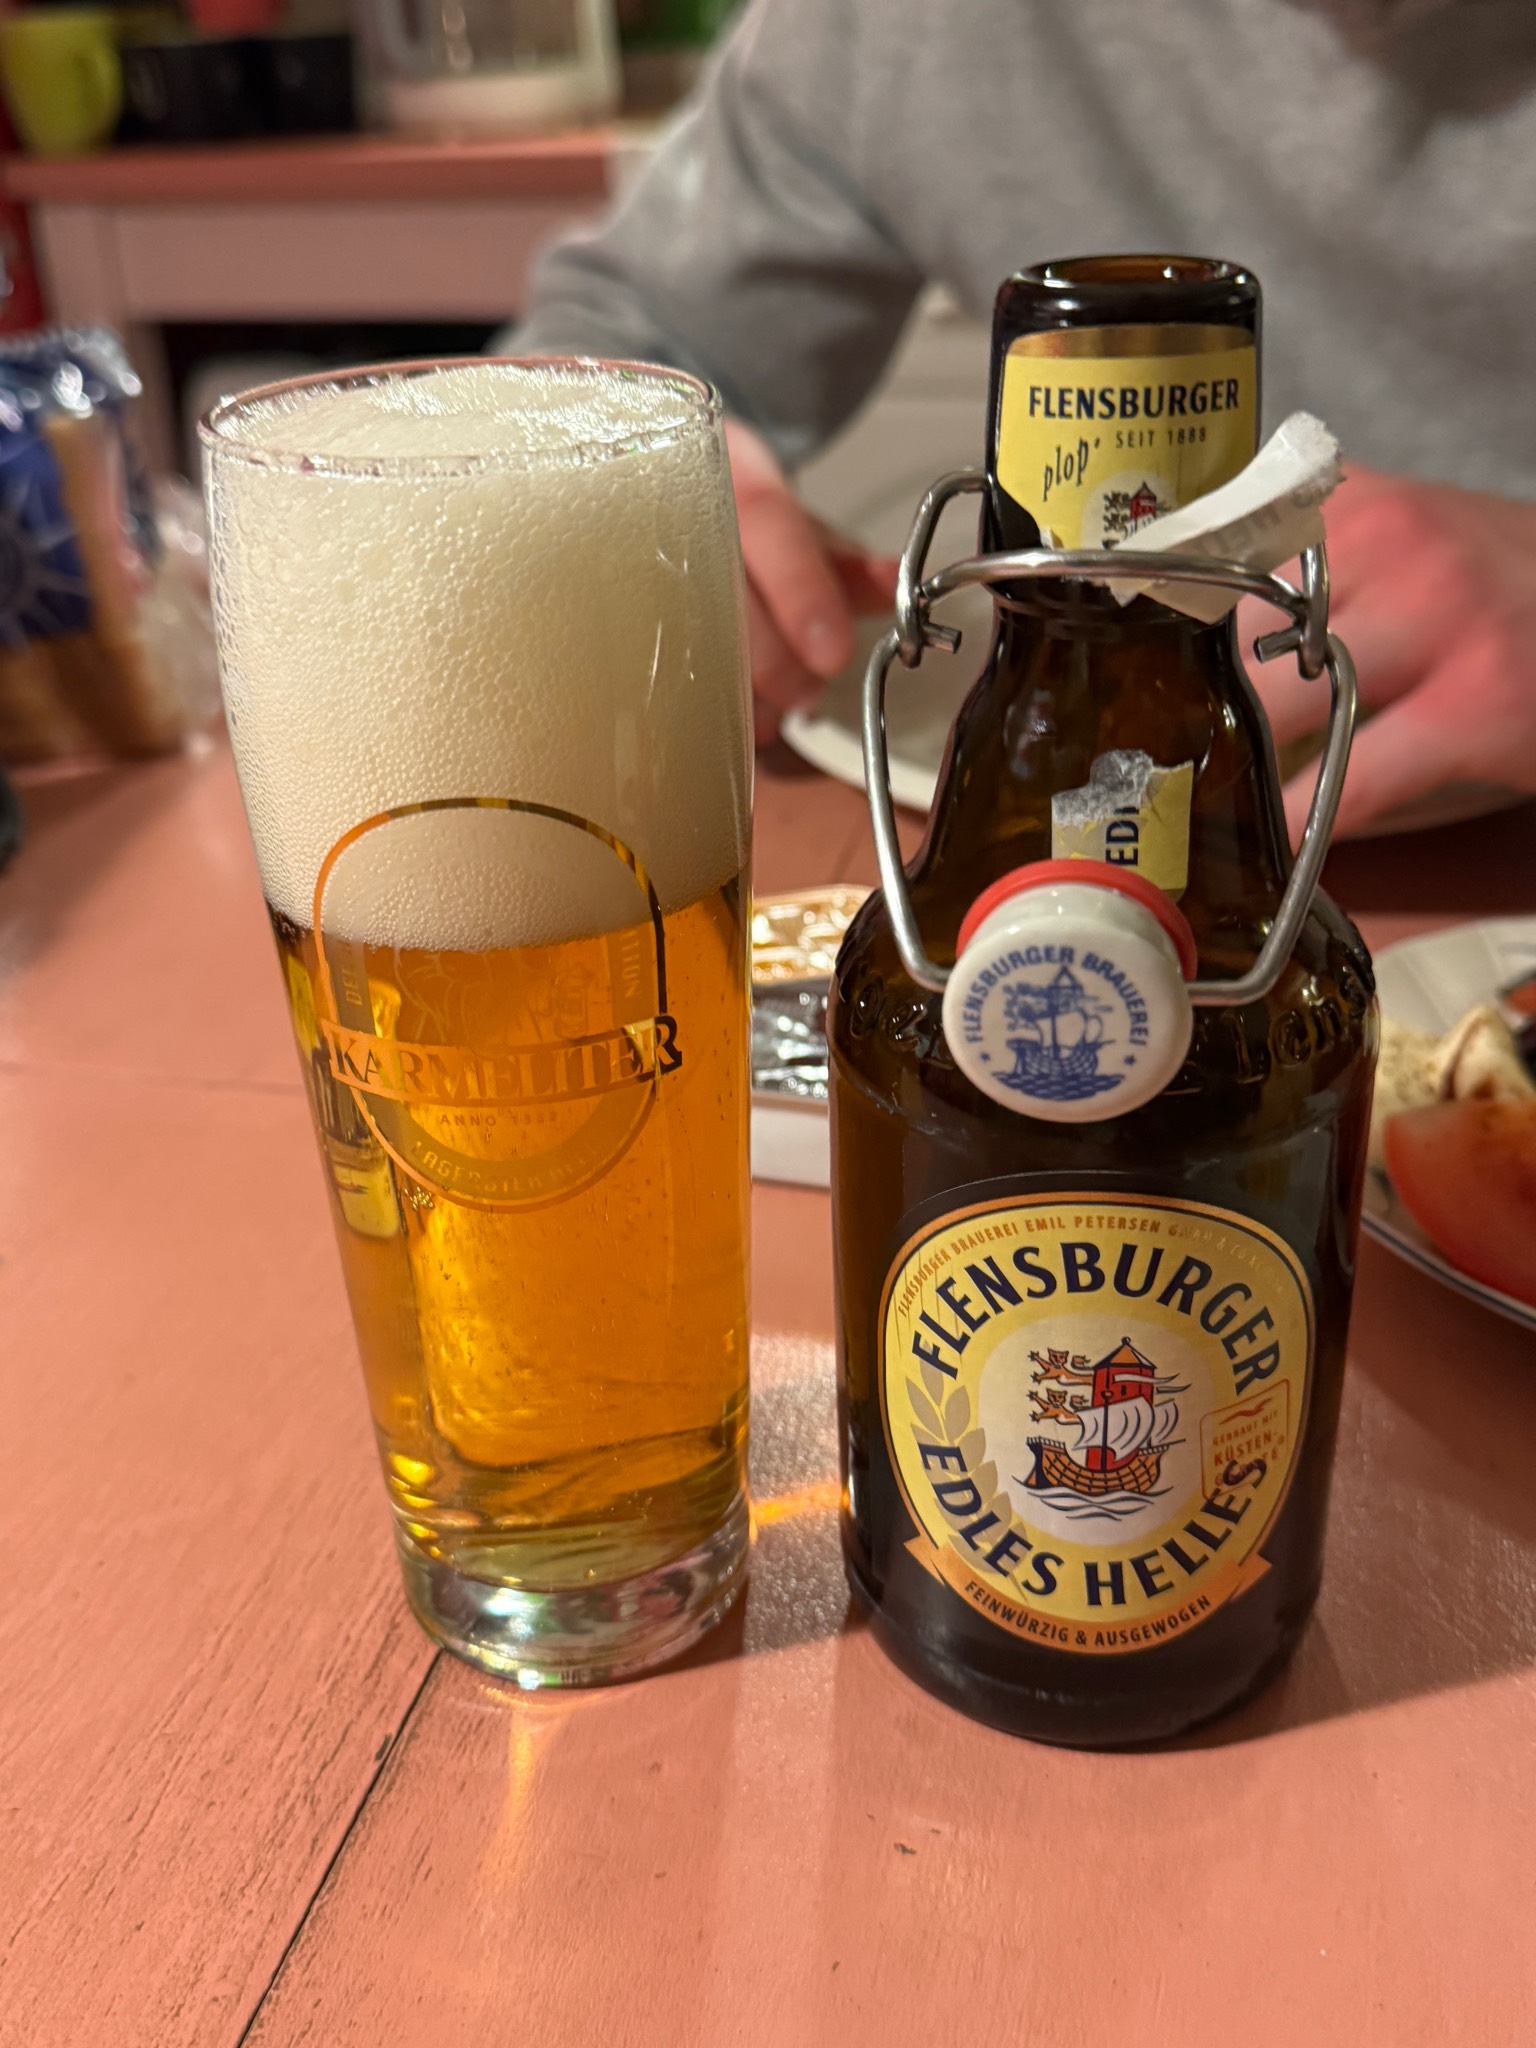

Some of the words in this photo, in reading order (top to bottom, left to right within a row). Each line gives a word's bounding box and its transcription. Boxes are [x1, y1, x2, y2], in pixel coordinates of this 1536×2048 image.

[1029, 378, 1239, 420] FLENSBURGER
[1115, 431, 1155, 449] SEIT
[1167, 427, 1207, 445] 1888
[962, 944, 1075, 1043] FLENSBURGER
[1080, 952, 1151, 1047] BRAUEREI
[322, 1013, 683, 1102] KARMELITER
[440, 1113, 497, 1127] ANNO
[897, 1249, 952, 1318] FLENSBURGER
[950, 1221, 1019, 1256] BRAUEREI
[1024, 1215, 1066, 1233] EMIL
[1074, 1215, 1161, 1234] PETERSEN
[912, 1241, 1281, 1396] FLENSBURGER
[916, 1441, 1064, 1596] EDLES
[1083, 1458, 1268, 1606] HELLES
[964, 1580, 1070, 1643] FEINWÜRZIG
[1075, 1630, 1088, 1646] &
[1094, 1595, 1211, 1647] AUSGEWOGEN
